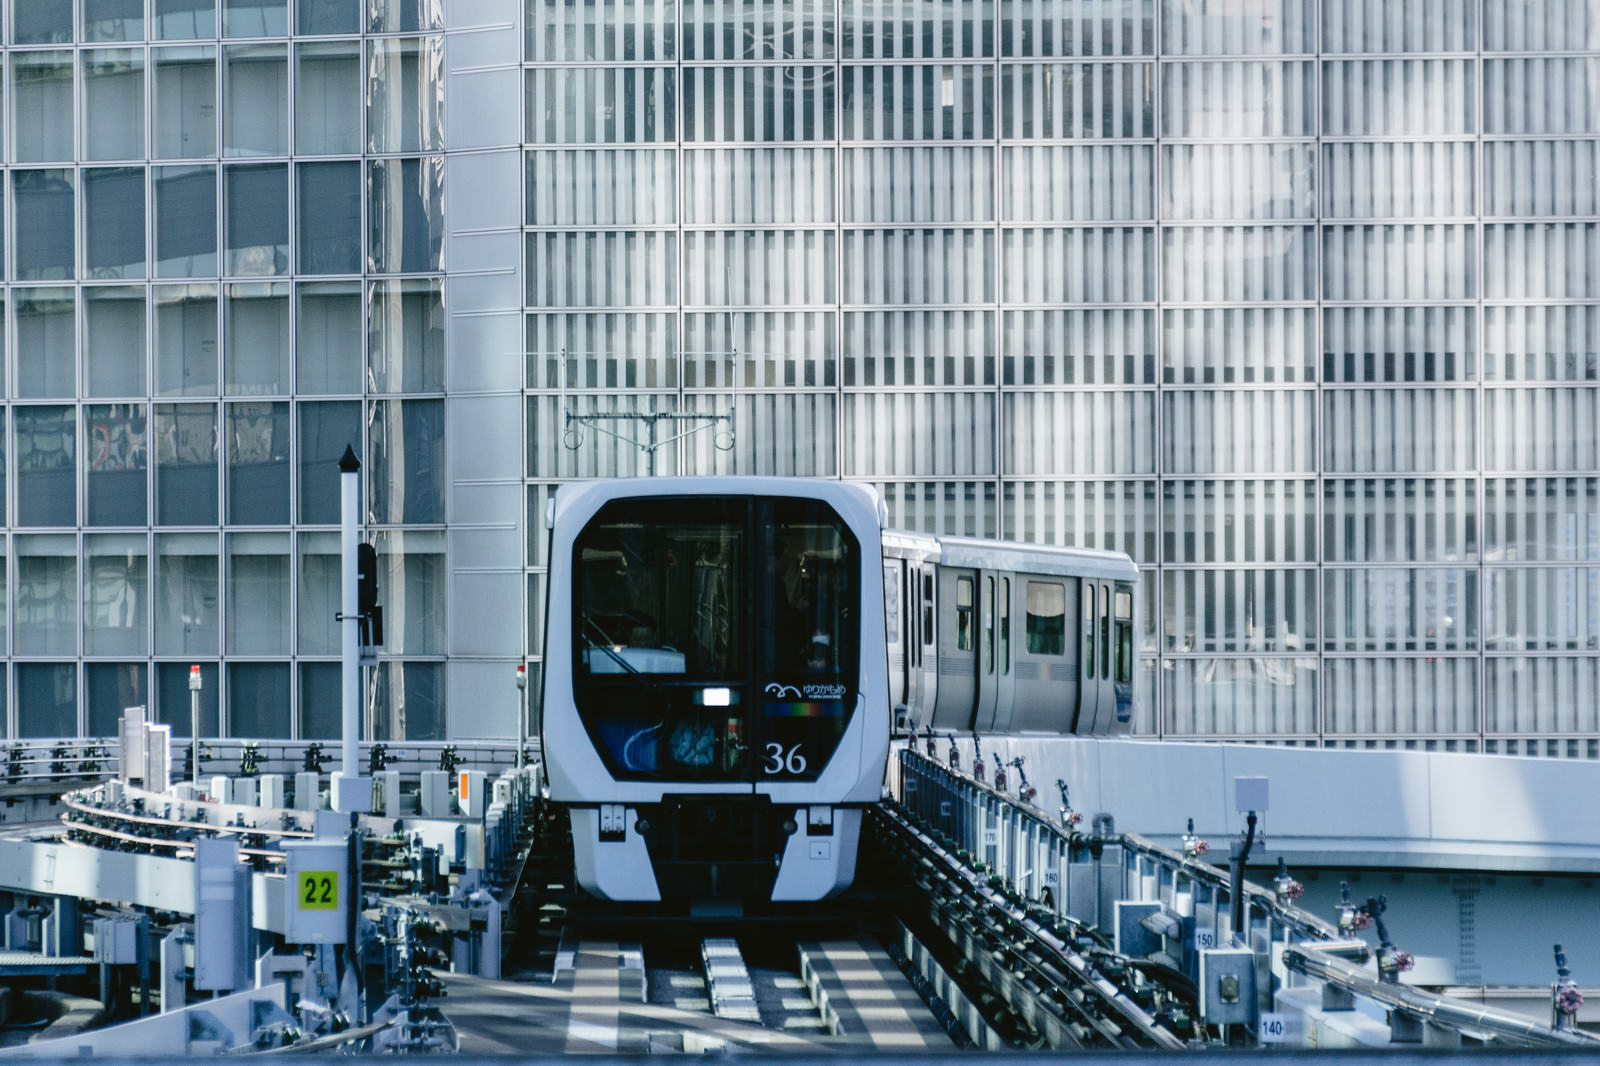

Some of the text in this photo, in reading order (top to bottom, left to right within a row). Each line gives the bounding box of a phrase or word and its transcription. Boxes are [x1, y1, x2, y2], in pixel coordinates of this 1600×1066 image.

[764, 742, 807, 774] 36
[984, 833, 996, 842] 170
[1045, 873, 1058, 883] 160
[305, 878, 332, 903] 22
[1197, 933, 1213, 946] 150
[1263, 1020, 1282, 1036] 140
